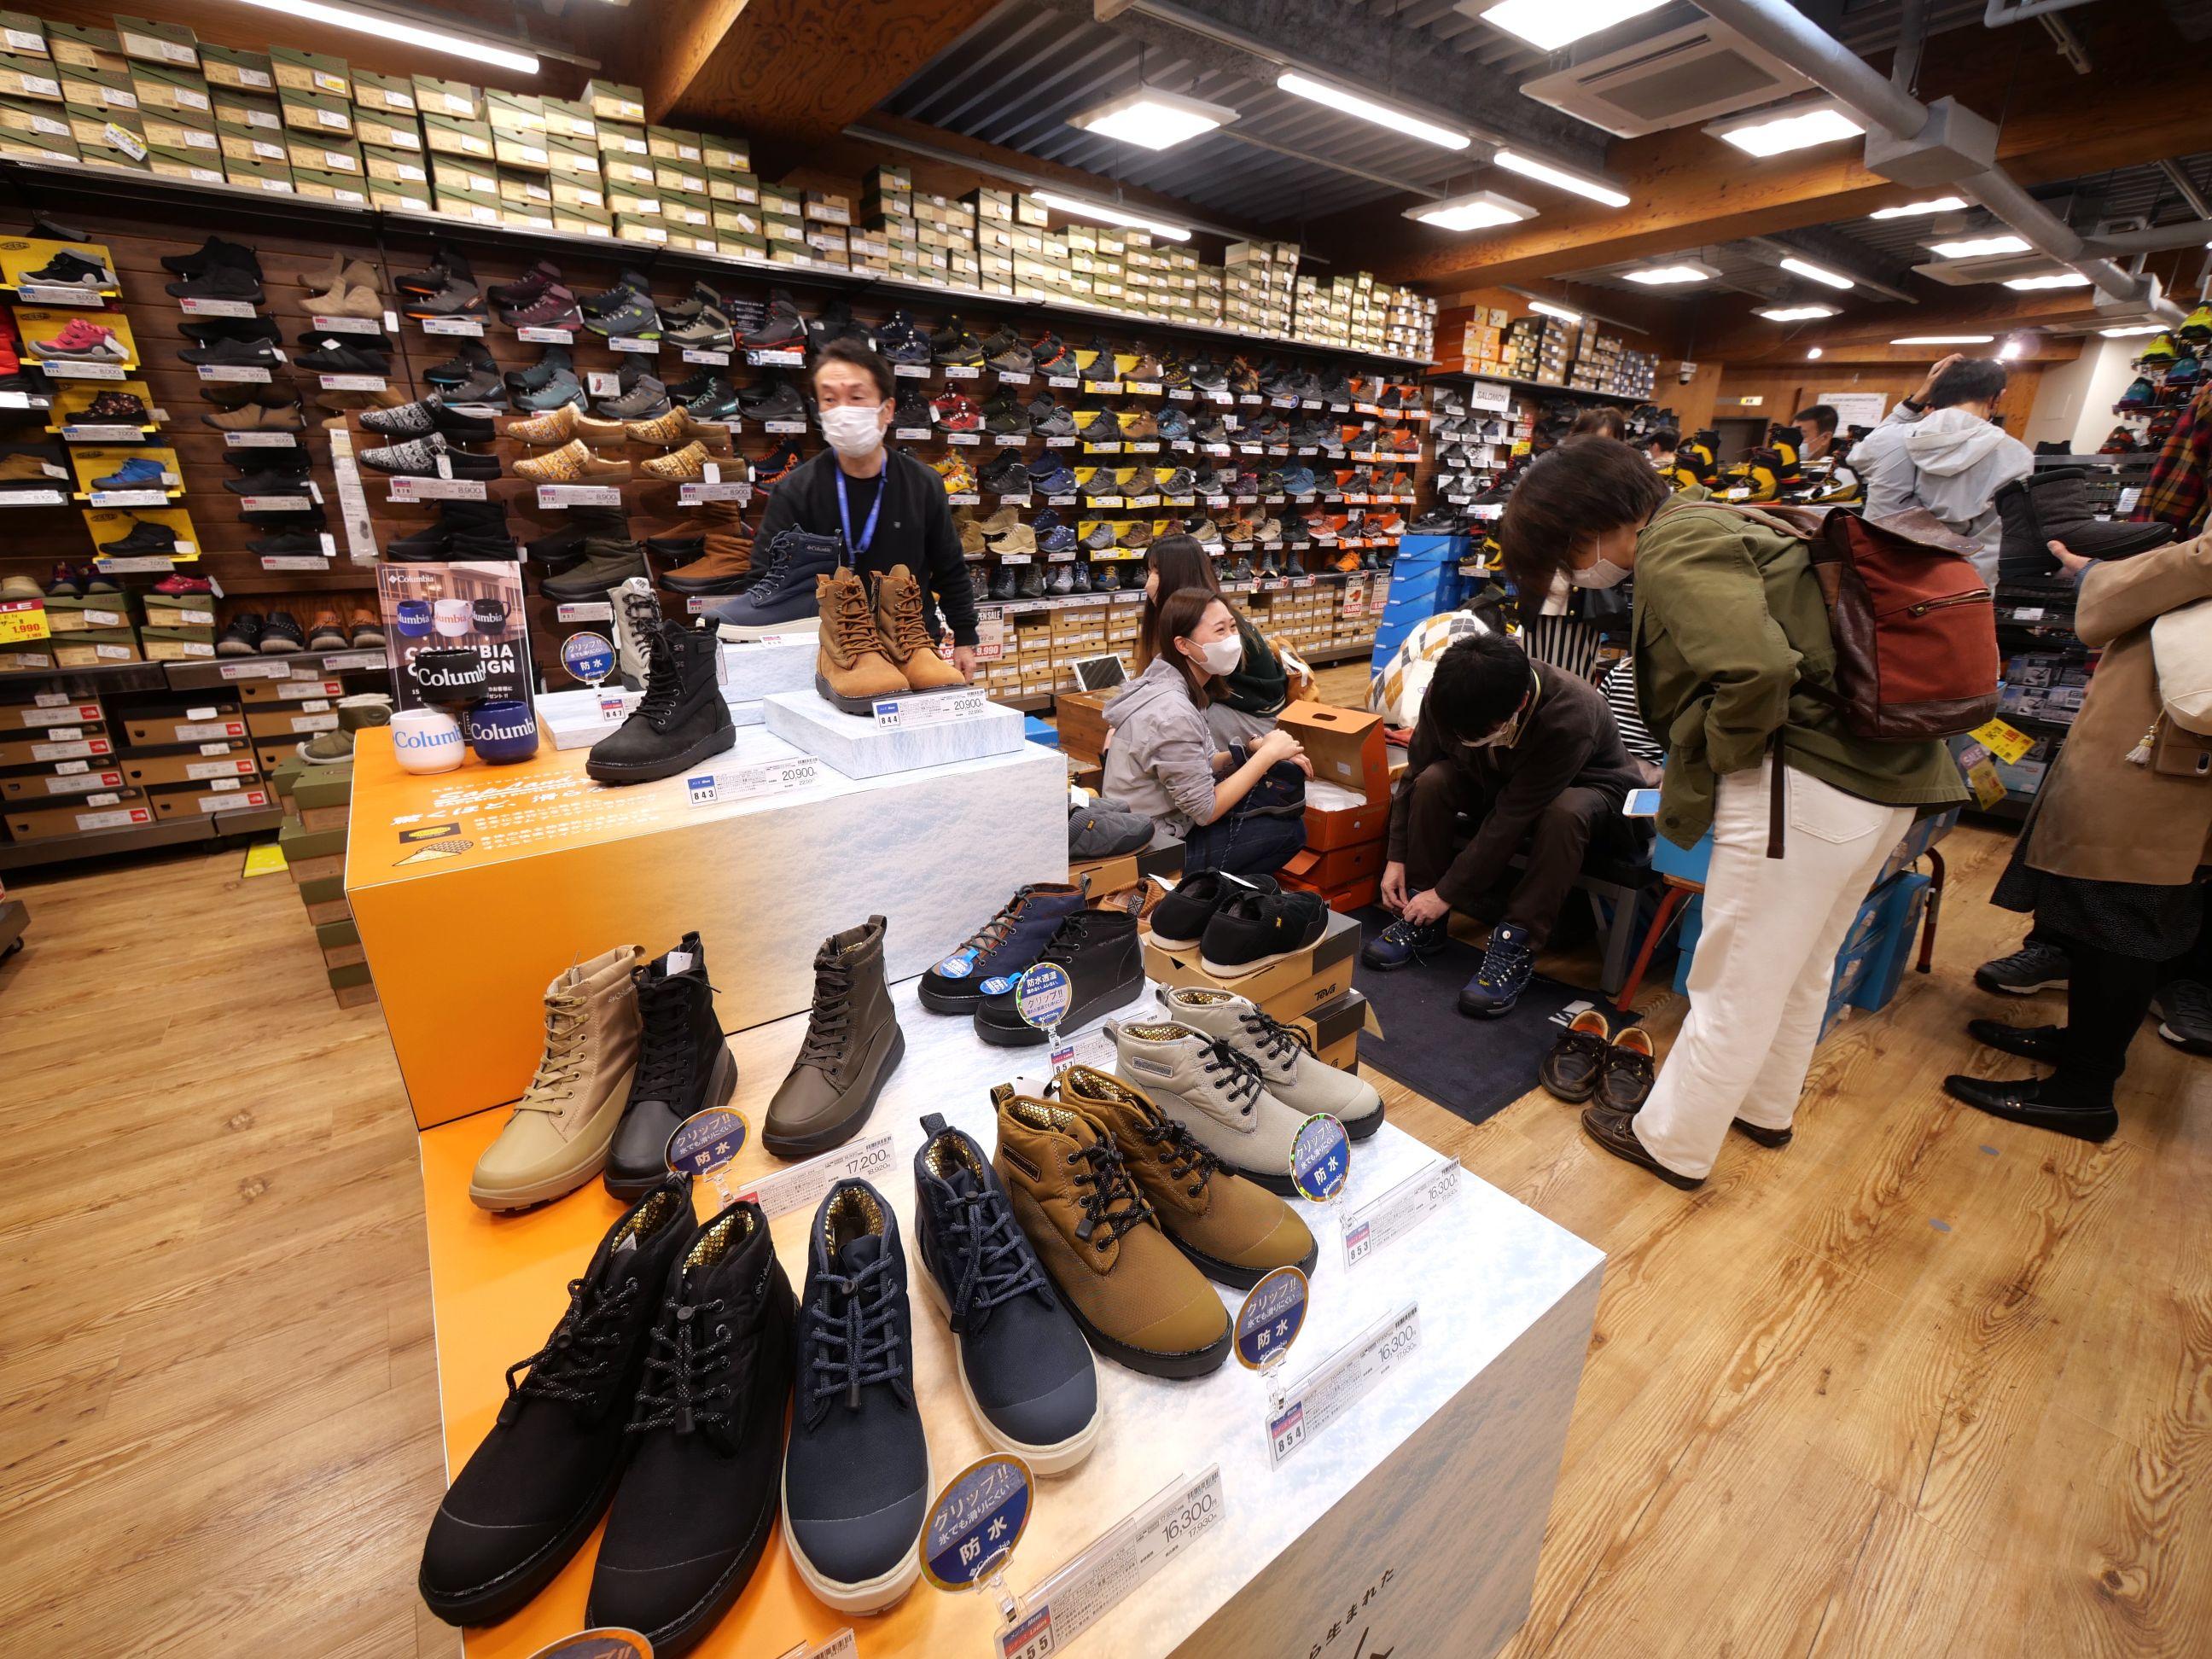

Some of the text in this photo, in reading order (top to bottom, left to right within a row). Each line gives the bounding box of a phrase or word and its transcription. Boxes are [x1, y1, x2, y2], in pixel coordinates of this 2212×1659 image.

[1476, 391, 1506, 402] SALOMON
[398, 574, 434, 584] Columbia
[0, 602, 32, 612] LE
[987, 610, 1001, 620] SALE
[580, 659, 603, 672] 防水
[882, 715, 898, 725] 844
[1963, 748, 1984, 766] SALE
[694, 789, 714, 800] 843
[1027, 970, 1057, 988] 防水透湿
[677, 1113, 731, 1147] グリップ!!
[695, 1141, 731, 1167] 防水
[1313, 1155, 1339, 1185] 防水
[1351, 1241, 1369, 1260] 853
[1247, 1278, 1296, 1318] グリップ!!
[1247, 1294, 1296, 1329] 氷でも滑りにくい
[1258, 1318, 1289, 1350] 防水
[1278, 1426, 1301, 1452] 854
[934, 1464, 1009, 1532] グリップ!!
[939, 1485, 1010, 1546] 氷でも滑りにくい
[959, 1516, 1008, 1566] 防水
[1027, 1612, 1042, 1627] Mens
[1016, 1634, 1048, 1659] 55
